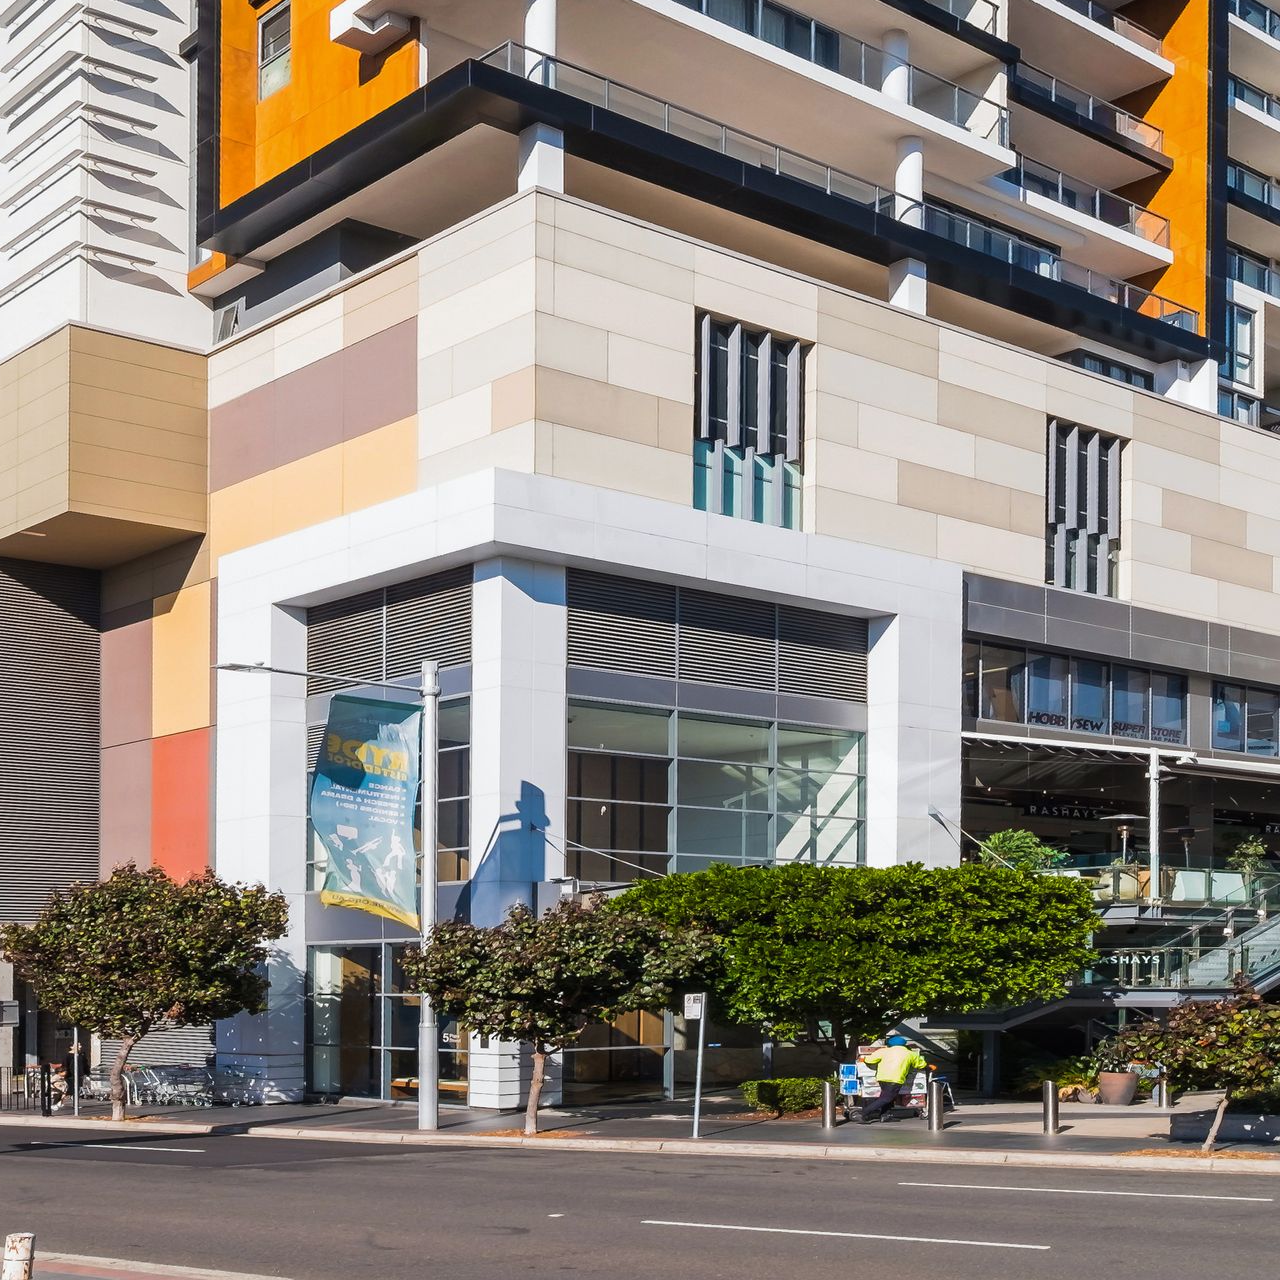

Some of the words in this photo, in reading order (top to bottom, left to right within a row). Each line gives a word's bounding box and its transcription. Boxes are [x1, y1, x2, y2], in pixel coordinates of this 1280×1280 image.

[1029, 805, 1097, 819] RASHAYS
[1099, 955, 1161, 964] ASHAYS
[442, 1032, 450, 1043] 5
